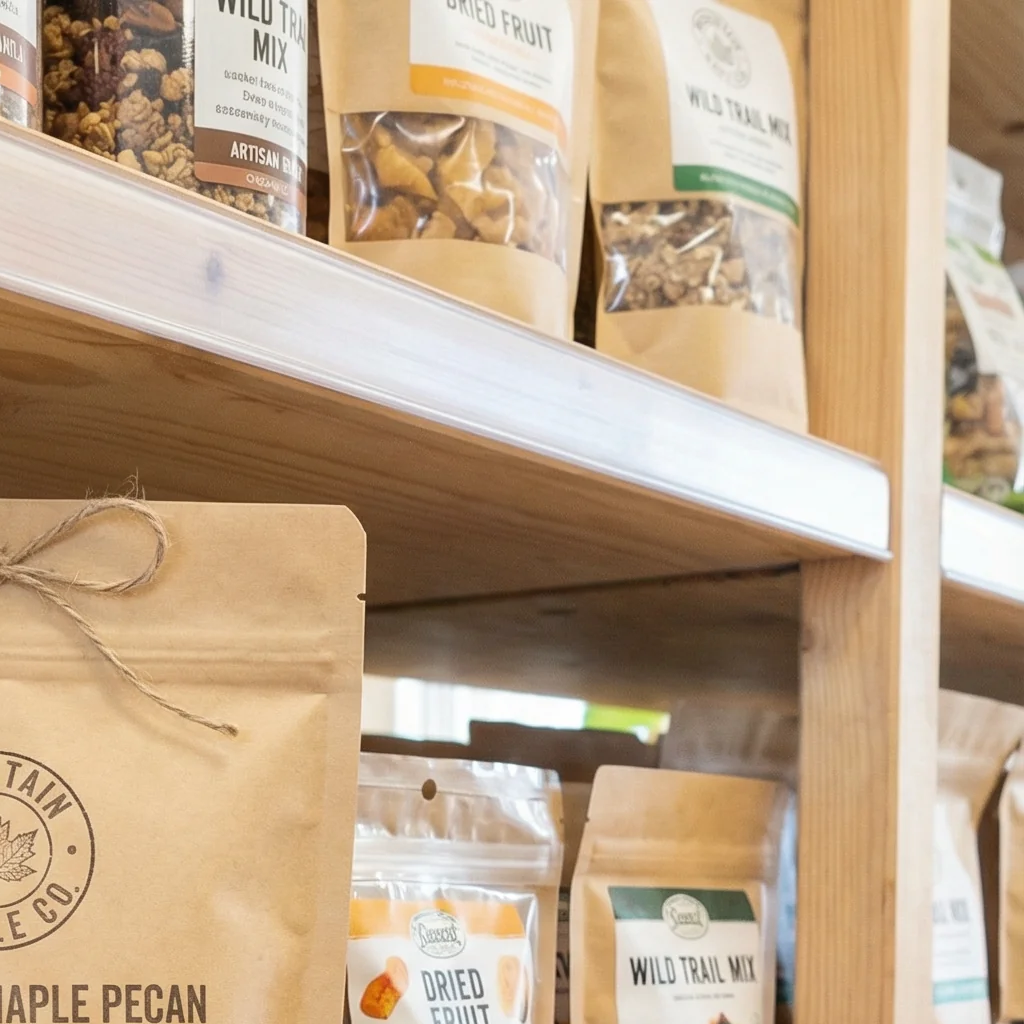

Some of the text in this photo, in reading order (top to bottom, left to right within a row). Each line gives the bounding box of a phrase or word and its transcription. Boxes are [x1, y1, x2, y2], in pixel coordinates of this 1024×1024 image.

[252, 28, 288, 74] MIX
[501, 9, 553, 53] FRUIT
[685, 83, 724, 117] WILD
[725, 97, 767, 134] TRAIL
[230, 140, 280, 171] ARTISAN
[36, 881, 80, 924] CO.
[420, 968, 485, 1002] DRIED
[629, 953, 757, 987] WILD TRAIL MIX
[101, 984, 207, 1024] PECAN
